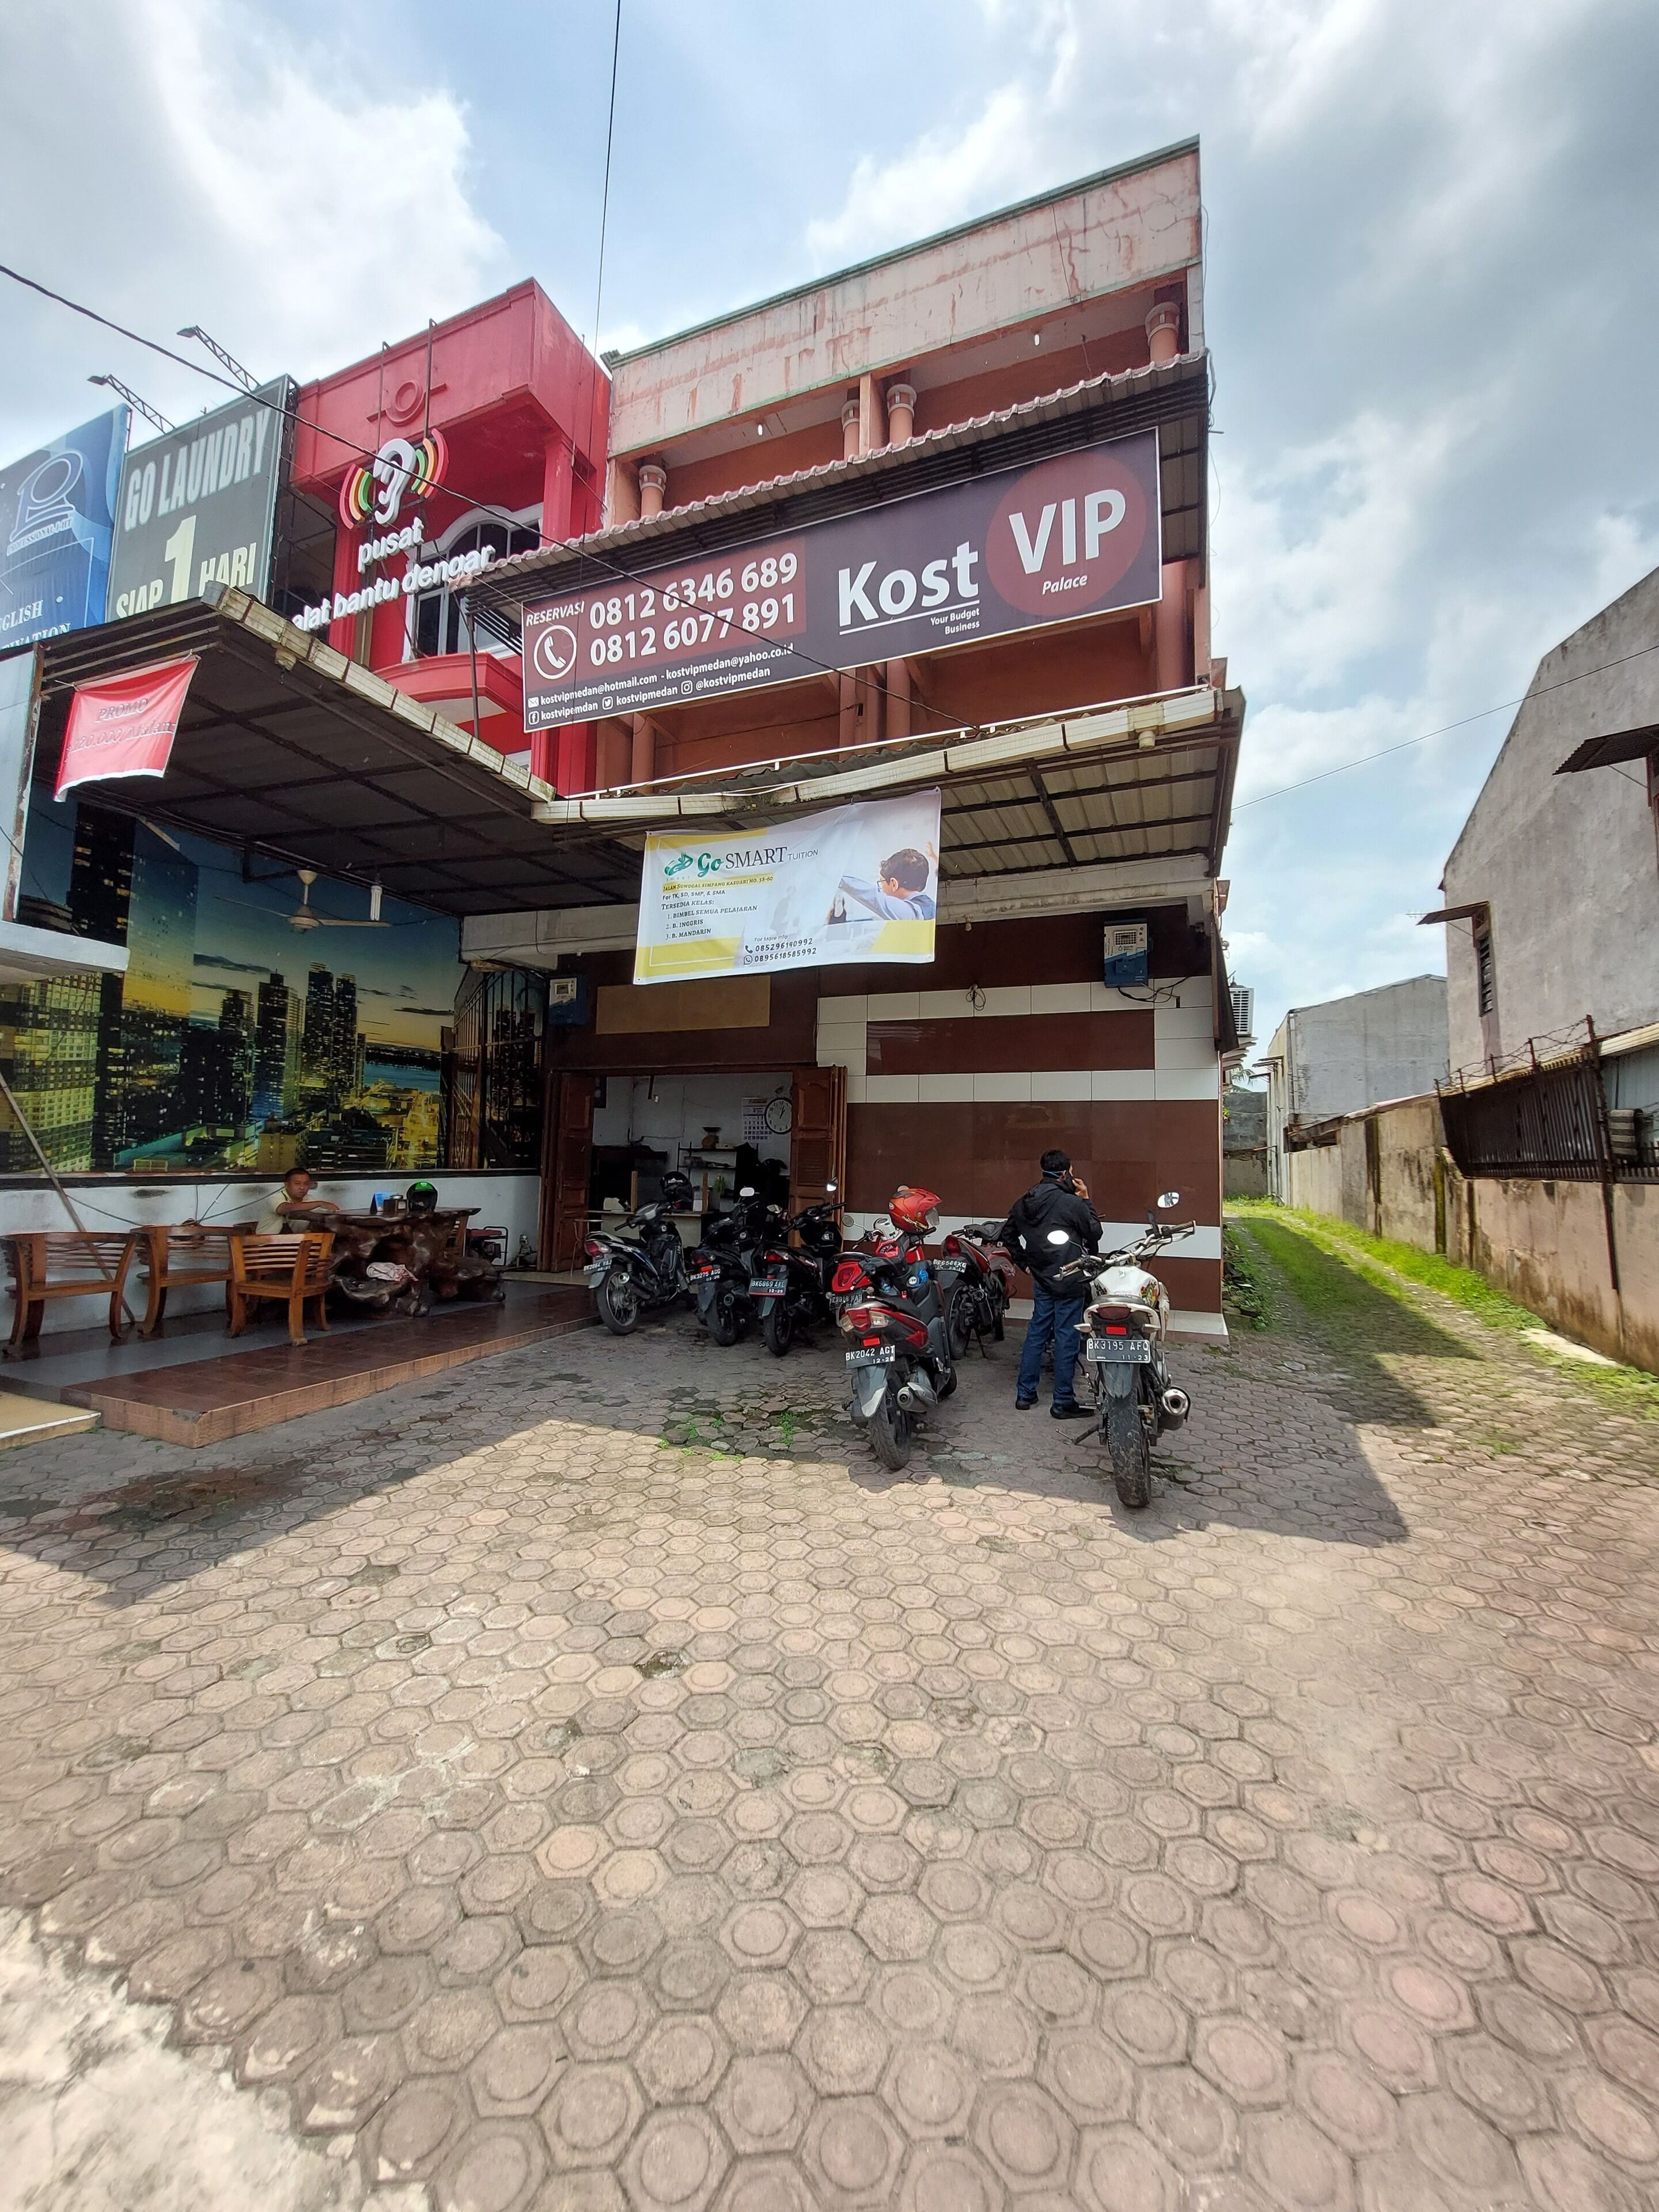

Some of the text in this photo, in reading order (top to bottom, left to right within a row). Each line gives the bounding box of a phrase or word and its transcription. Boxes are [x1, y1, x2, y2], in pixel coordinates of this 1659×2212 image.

[124, 407, 272, 532] GO LAUNDRY
[1008, 489, 1126, 574] VIP
[358, 516, 424, 574] pusat
[116, 514, 257, 619] SIAP 1 HARI
[291, 545, 495, 632] alat bantu dengar
[590, 553, 797, 629] 0812 6346 689
[839, 541, 979, 626] Kost
[1041, 575, 1088, 594] Palace
[526, 601, 585, 627] RESERVASI
[930, 607, 979, 626] Your Budget
[590, 593, 793, 666] 0812 6077 891
[945, 620, 980, 635] Business
[540, 674, 657, 706] kostvipmedan@hotmail.com
[666, 643, 793, 680] kostvipmedan@yahoo.co.id
[696, 668, 770, 691] @kostvipmedan
[616, 685, 678, 706] kostvipmedan
[698, 846, 819, 877] Go SMART TUITION
[661, 902, 690, 910] TERSEDIA
[673, 910, 695, 919] BIMBEL
[720, 905, 757, 914] PELAJARAN
[679, 919, 703, 927] INGGRIS
[679, 929, 711, 938] MANDARIN
[846, 1348, 875, 1361] BK2042
[1088, 1340, 1124, 1350] BK3195
